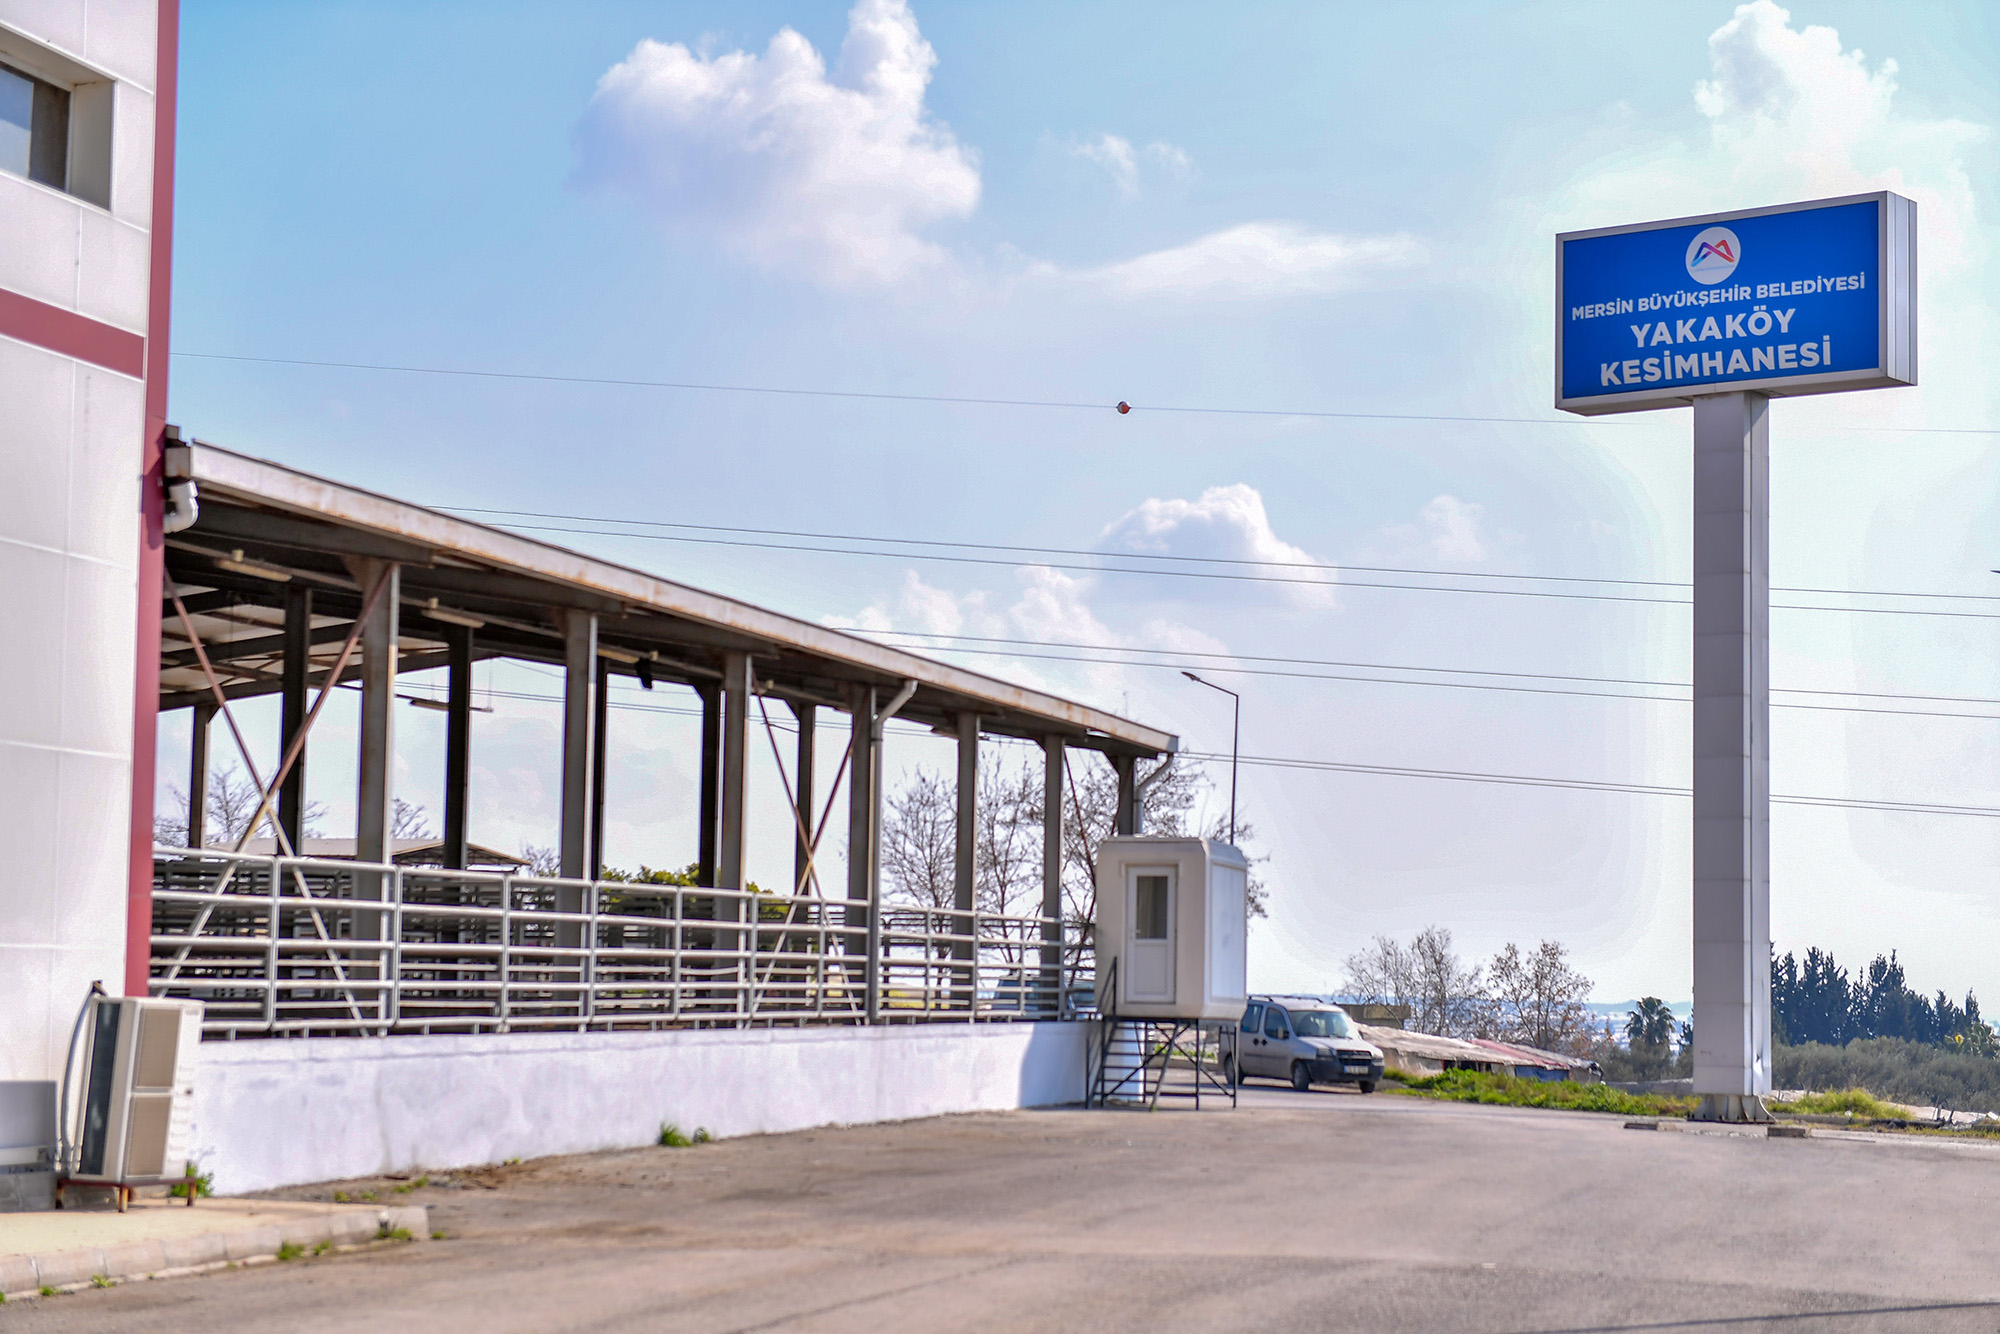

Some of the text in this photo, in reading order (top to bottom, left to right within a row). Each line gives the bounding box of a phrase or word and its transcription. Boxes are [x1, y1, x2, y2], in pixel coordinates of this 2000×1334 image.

[1572, 272, 1865, 320] MERSİN BÜYÜKŞEHİR BELEDİYESİ
[1630, 305, 1796, 348] YAKAKÖY
[1600, 334, 1831, 387] KESİMHANESİ
